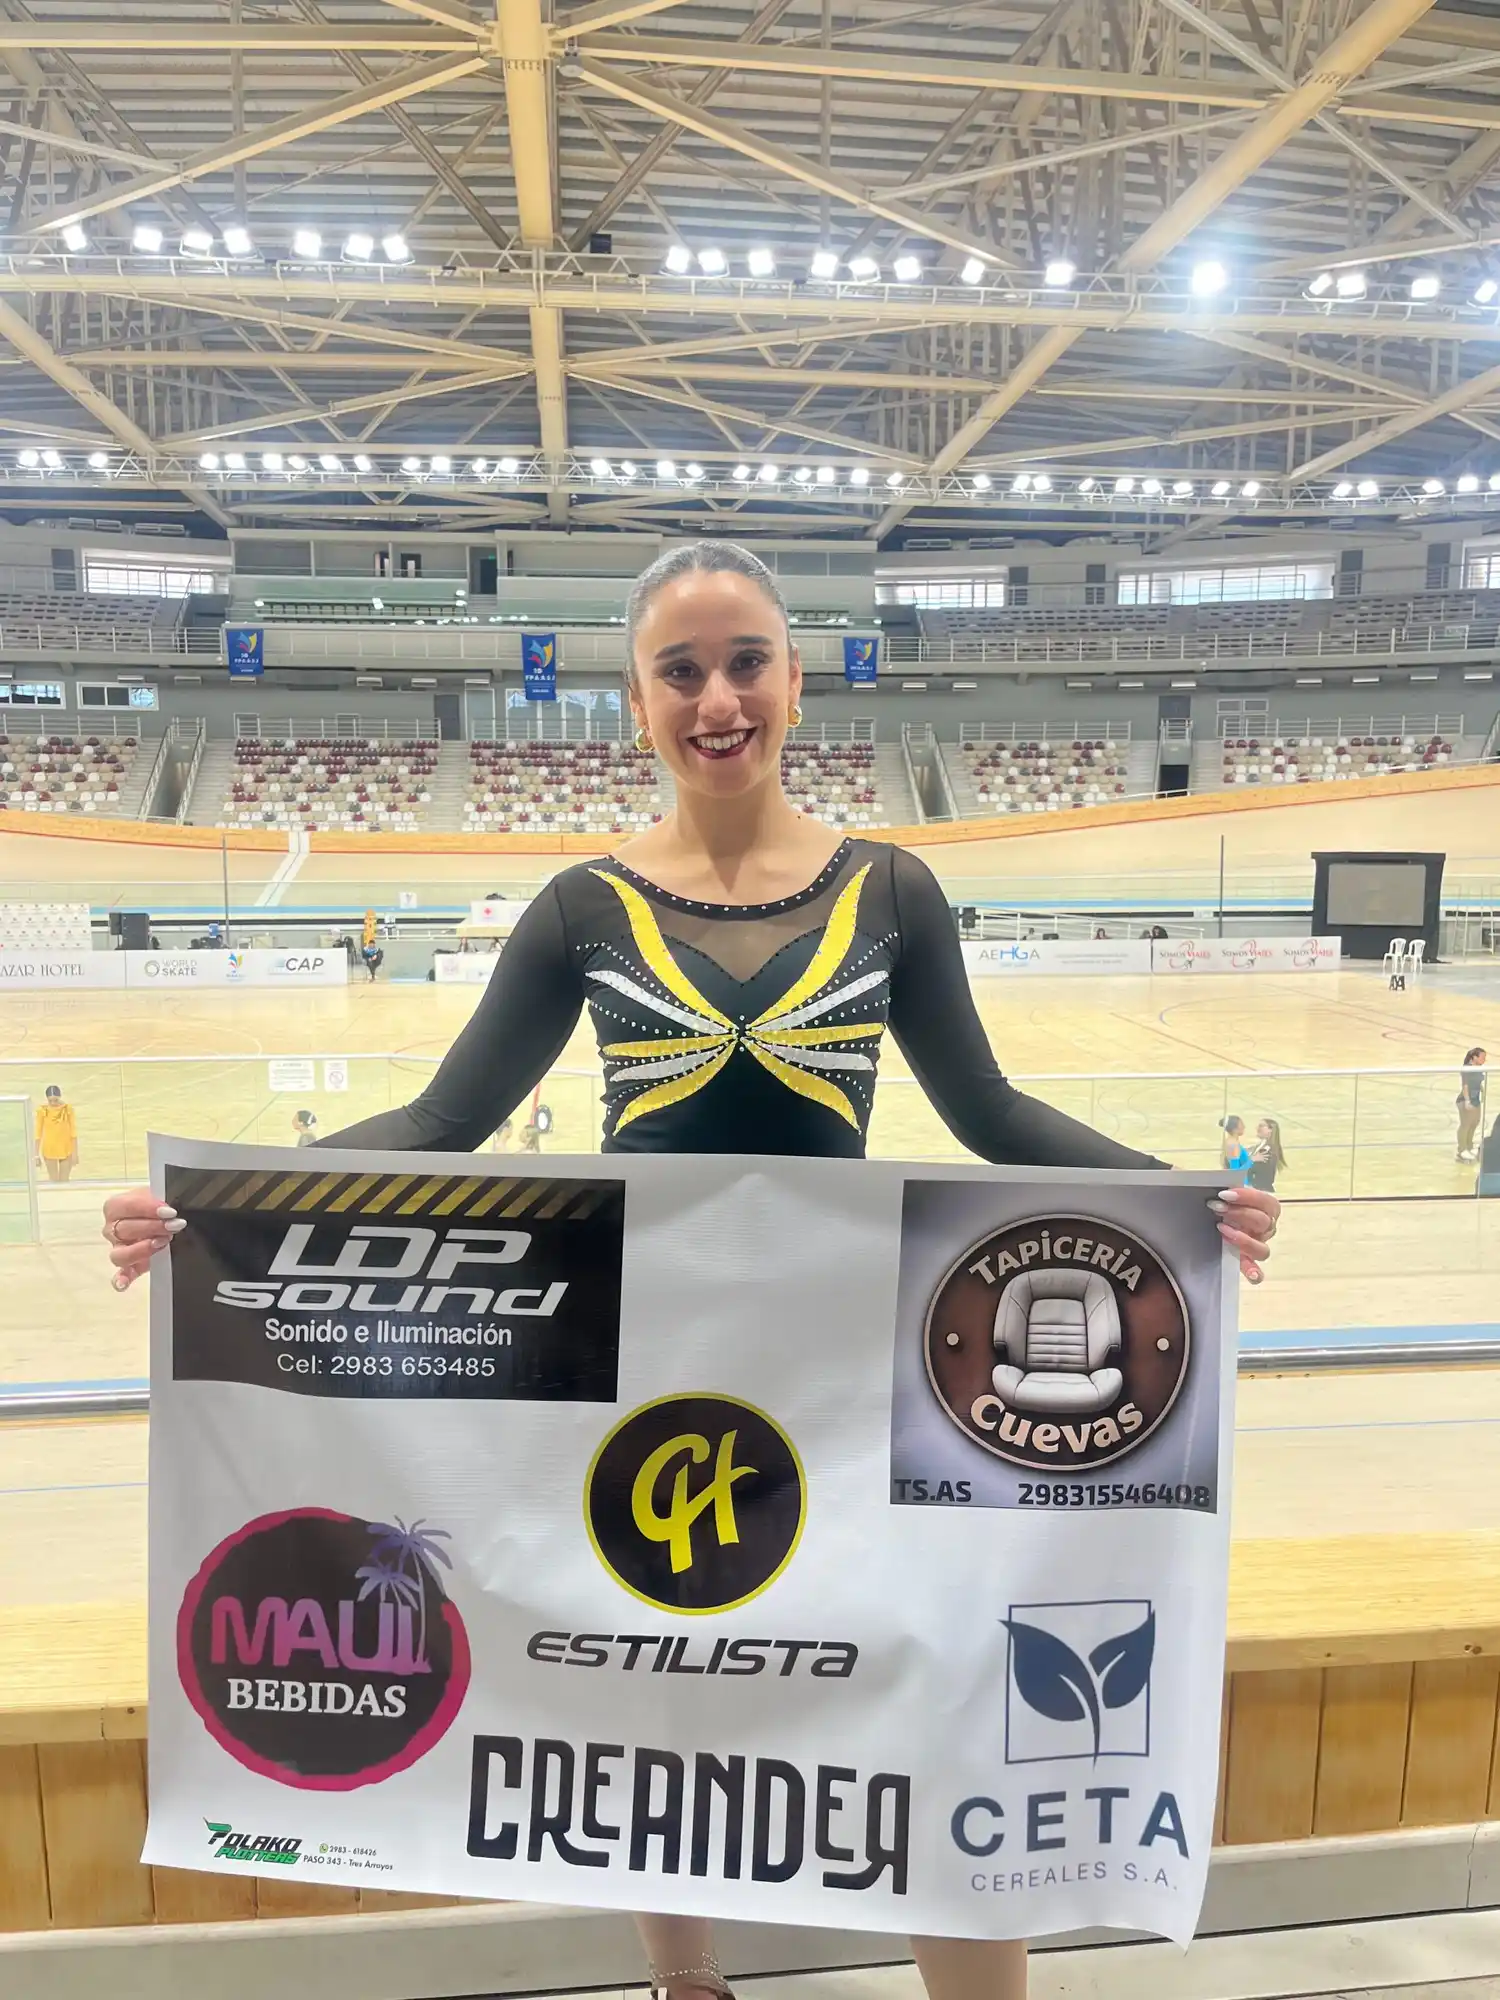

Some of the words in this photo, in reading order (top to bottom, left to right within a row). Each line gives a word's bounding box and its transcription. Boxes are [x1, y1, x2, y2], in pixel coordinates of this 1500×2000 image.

[41, 964, 84, 977] HOTEL
[162, 958, 197, 967] WORLD
[162, 967, 197, 976] SKATE
[285, 957, 324, 972] CAP
[267, 1224, 532, 1279] LDP
[265, 1318, 348, 1344] Sonido
[354, 1324, 369, 1344] e
[377, 1321, 512, 1346] Iluminación
[277, 1353, 323, 1376] Cel:
[330, 1356, 393, 1377] 2983
[401, 1357, 496, 1378] 653485
[970, 1394, 1143, 1453] Cuevas
[894, 1479, 972, 1503] TS.AS
[1018, 1482, 1210, 1508] 298315546408
[210, 1595, 420, 1675] MAUI
[227, 1678, 407, 1718] BEBIDAS
[950, 1787, 1190, 1859] CETA
[213, 1845, 302, 1864] PLOTTERS
[329, 1845, 347, 1854] 2983
[303, 1855, 325, 1864] PASO
[327, 1857, 342, 1866] 343
[349, 1859, 362, 1868] Tres
[364, 1860, 393, 1872] Arroyos
[971, 1861, 1107, 1892] CEREALES
[1124, 1862, 1178, 1890] S.A.
